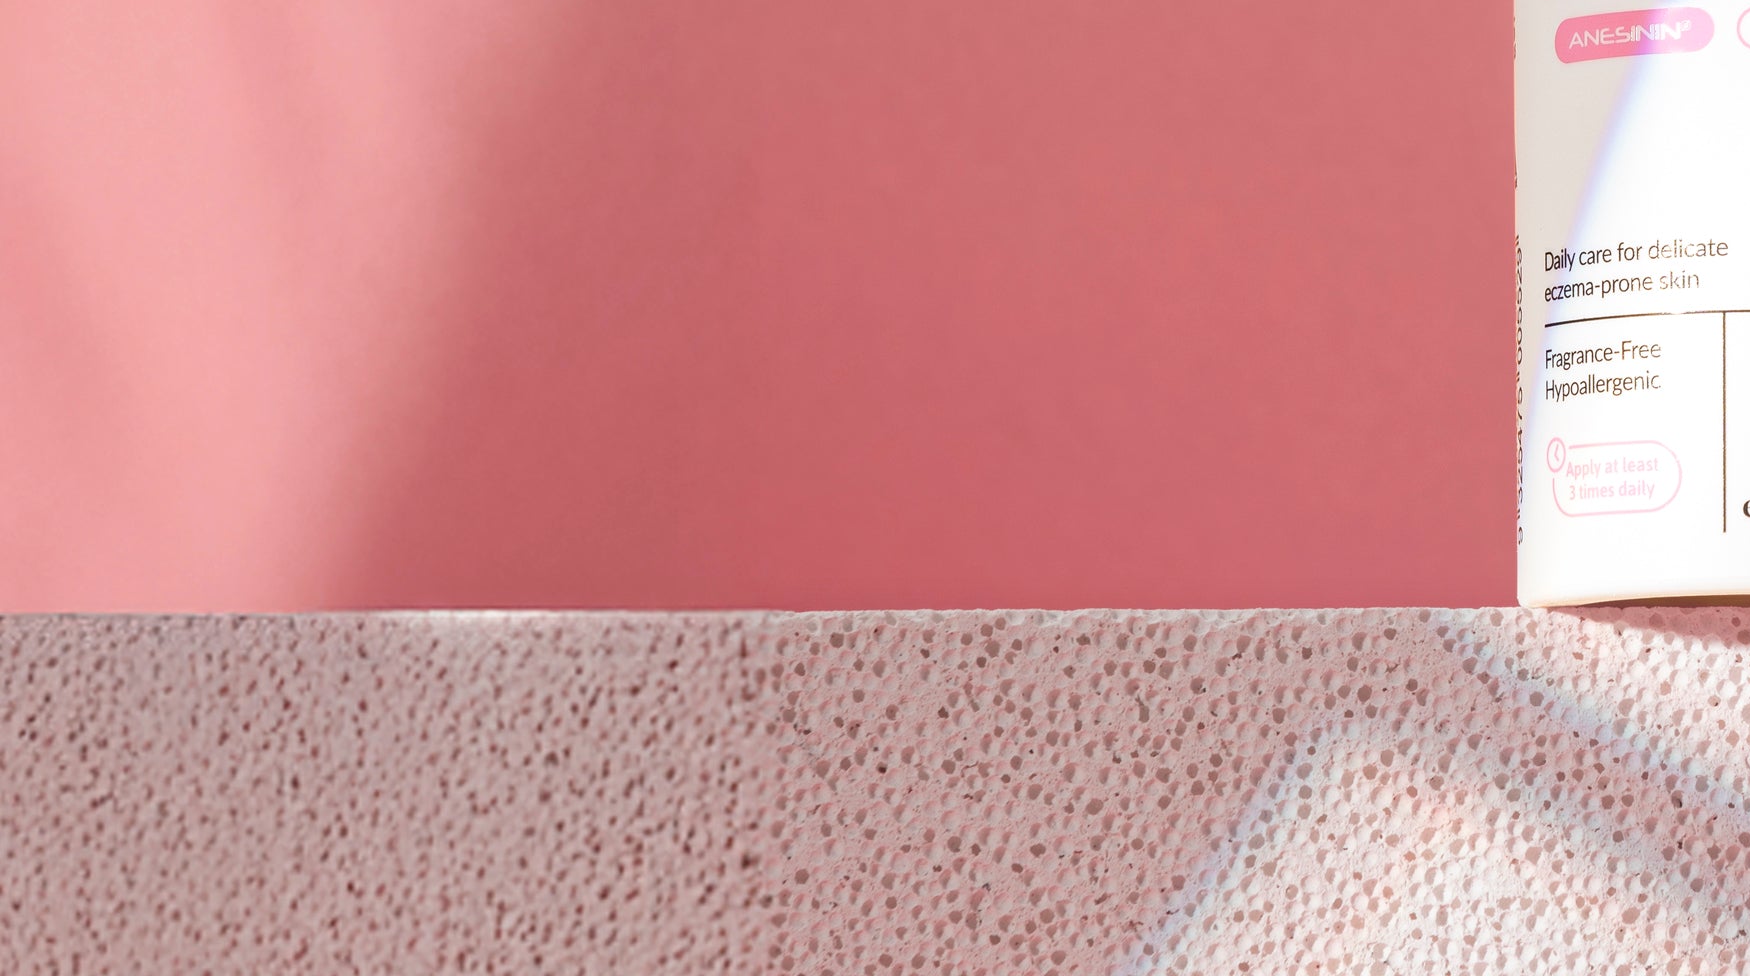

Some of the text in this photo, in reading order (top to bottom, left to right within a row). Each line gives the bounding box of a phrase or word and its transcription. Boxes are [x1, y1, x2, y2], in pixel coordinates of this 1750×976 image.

[1544, 239, 1729, 272] Daily care for delicate
[1544, 270, 1700, 302] eczema-prone skin
[1545, 340, 1661, 371] Fragrance-Free
[1545, 370, 1661, 402] Hypoallergenic
[1566, 457, 1659, 480] Apply at least
[1569, 480, 1655, 501] 3 times daily
